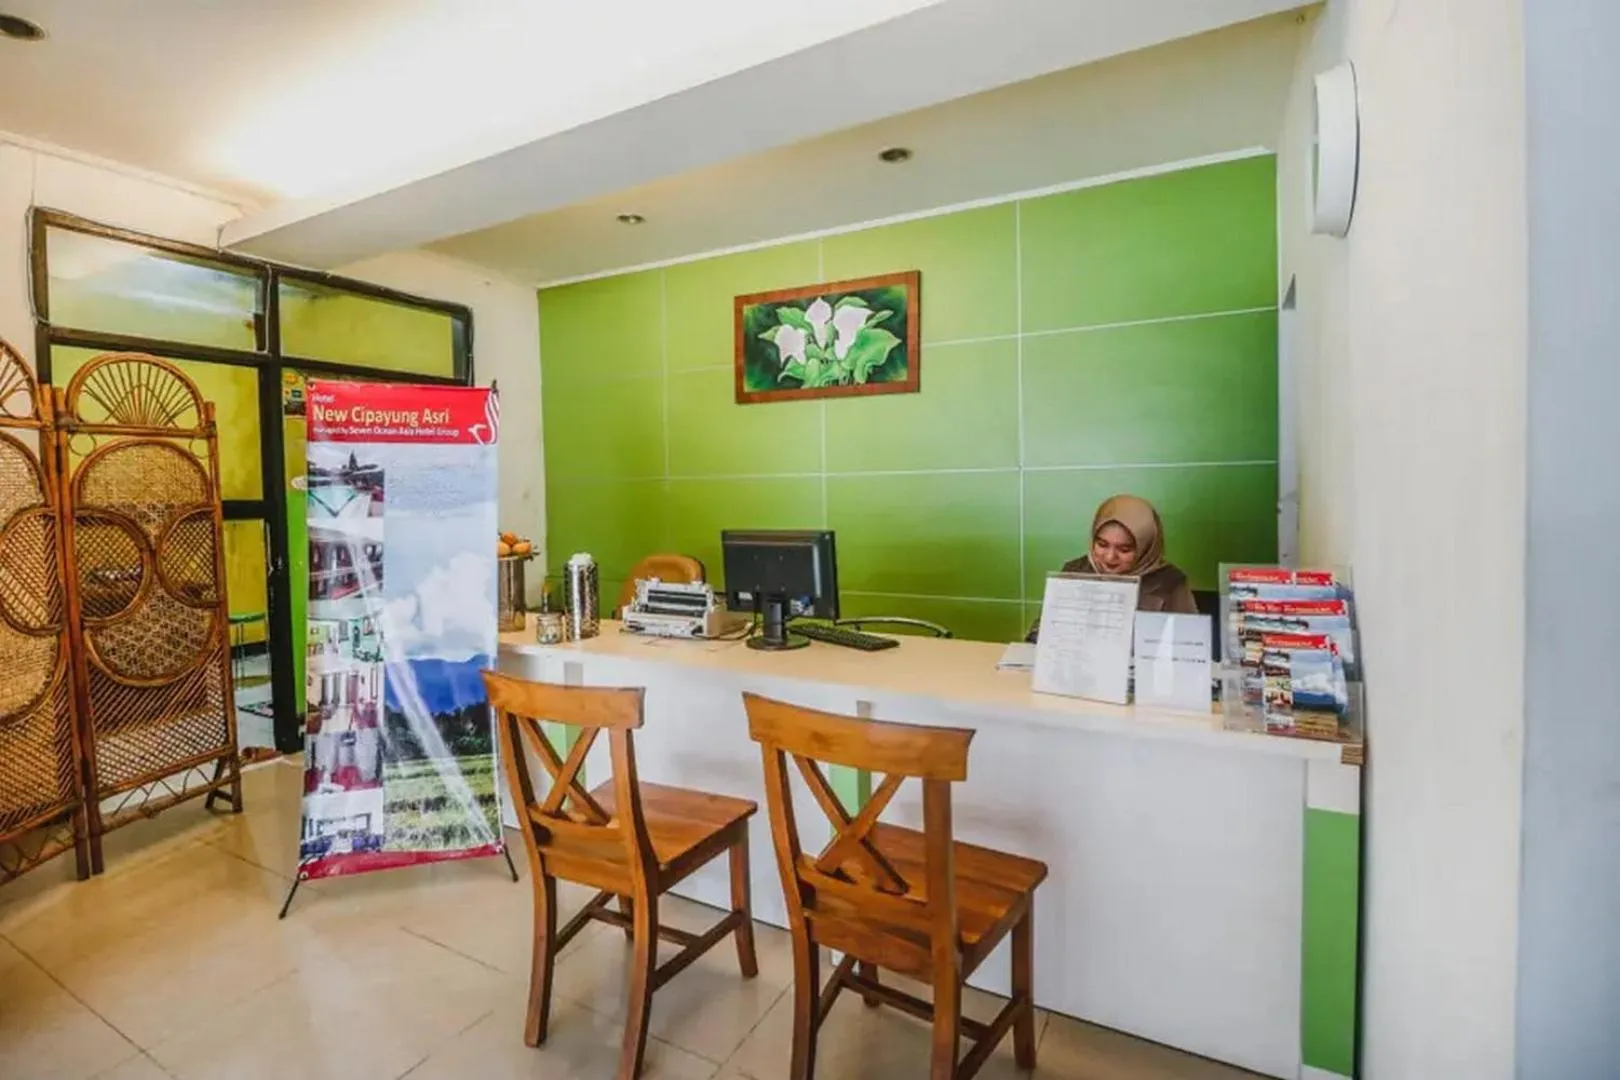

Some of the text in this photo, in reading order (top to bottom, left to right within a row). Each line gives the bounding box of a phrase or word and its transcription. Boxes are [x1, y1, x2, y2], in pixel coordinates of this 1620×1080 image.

[312, 394, 334, 403] Hotel
[313, 404, 449, 428] New Cipayung Asri
[349, 426, 371, 435] Seven
